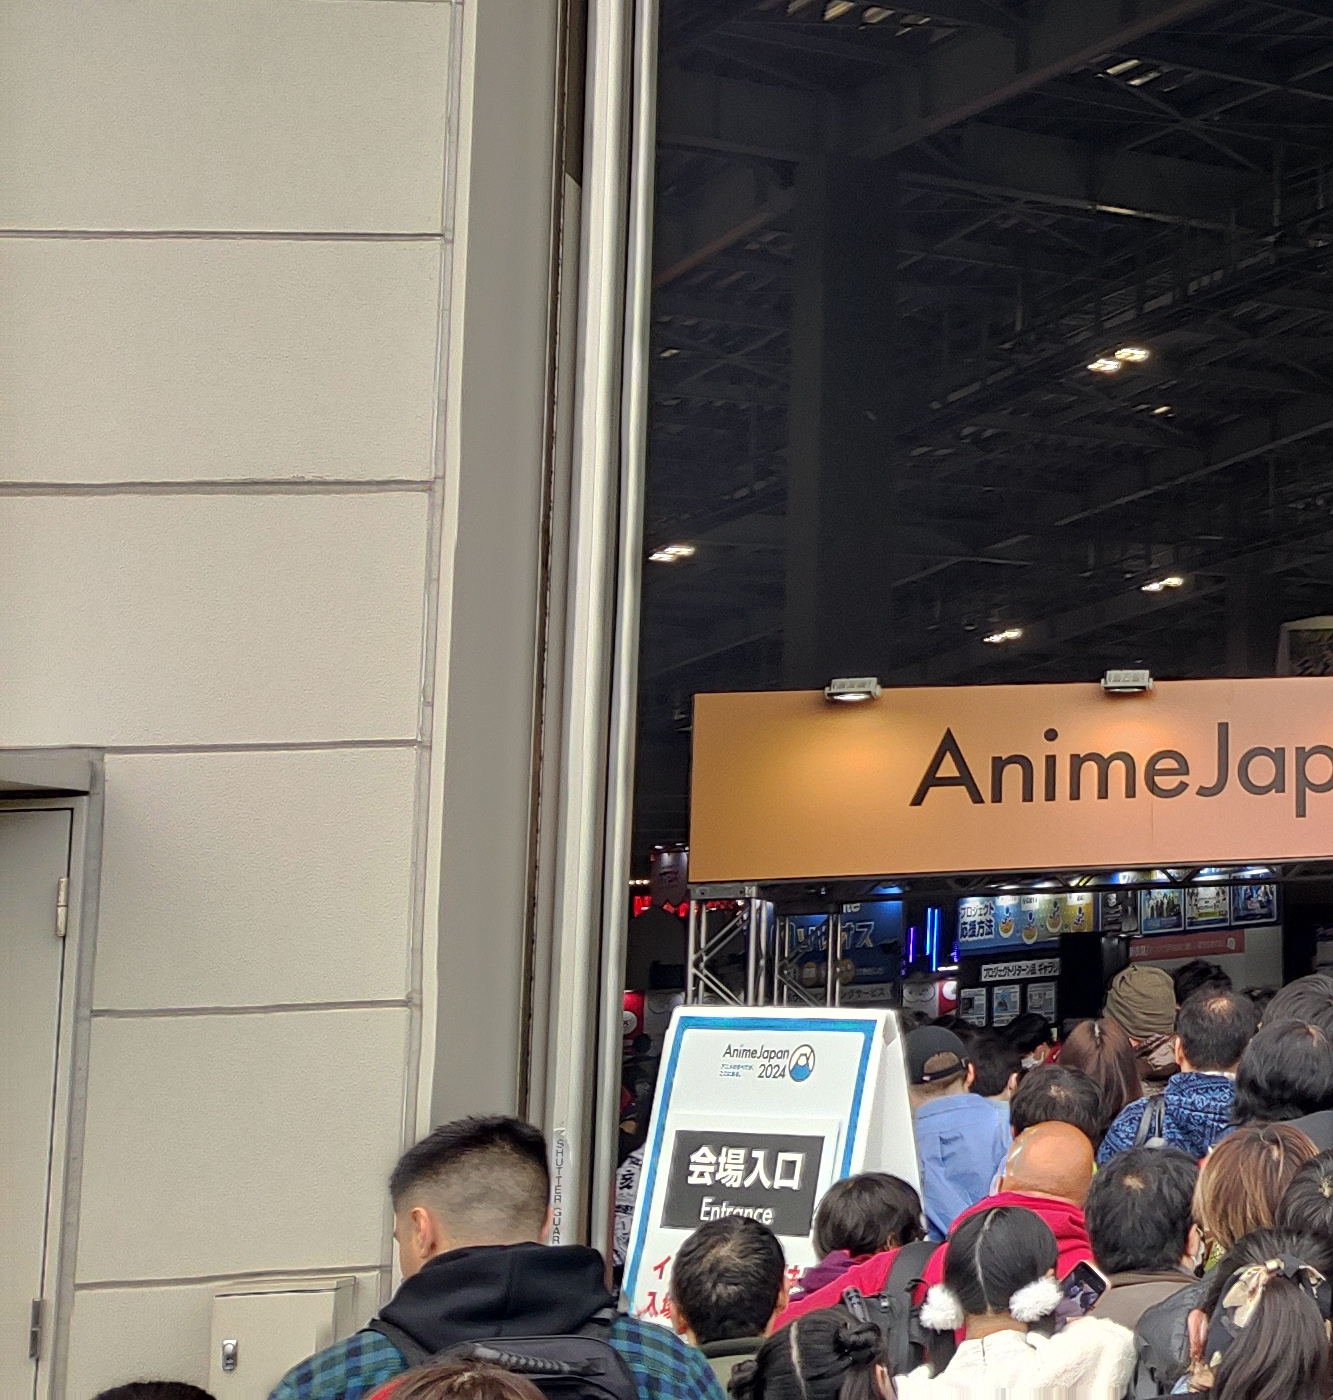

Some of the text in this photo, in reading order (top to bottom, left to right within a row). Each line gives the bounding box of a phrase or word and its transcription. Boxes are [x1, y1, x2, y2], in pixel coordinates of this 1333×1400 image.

[722, 1043, 790, 1063] AnimeJapan
[757, 1063, 787, 1079] 2024
[554, 1138, 565, 1203] SHUTTER
[687, 1144, 806, 1191] 会場入口
